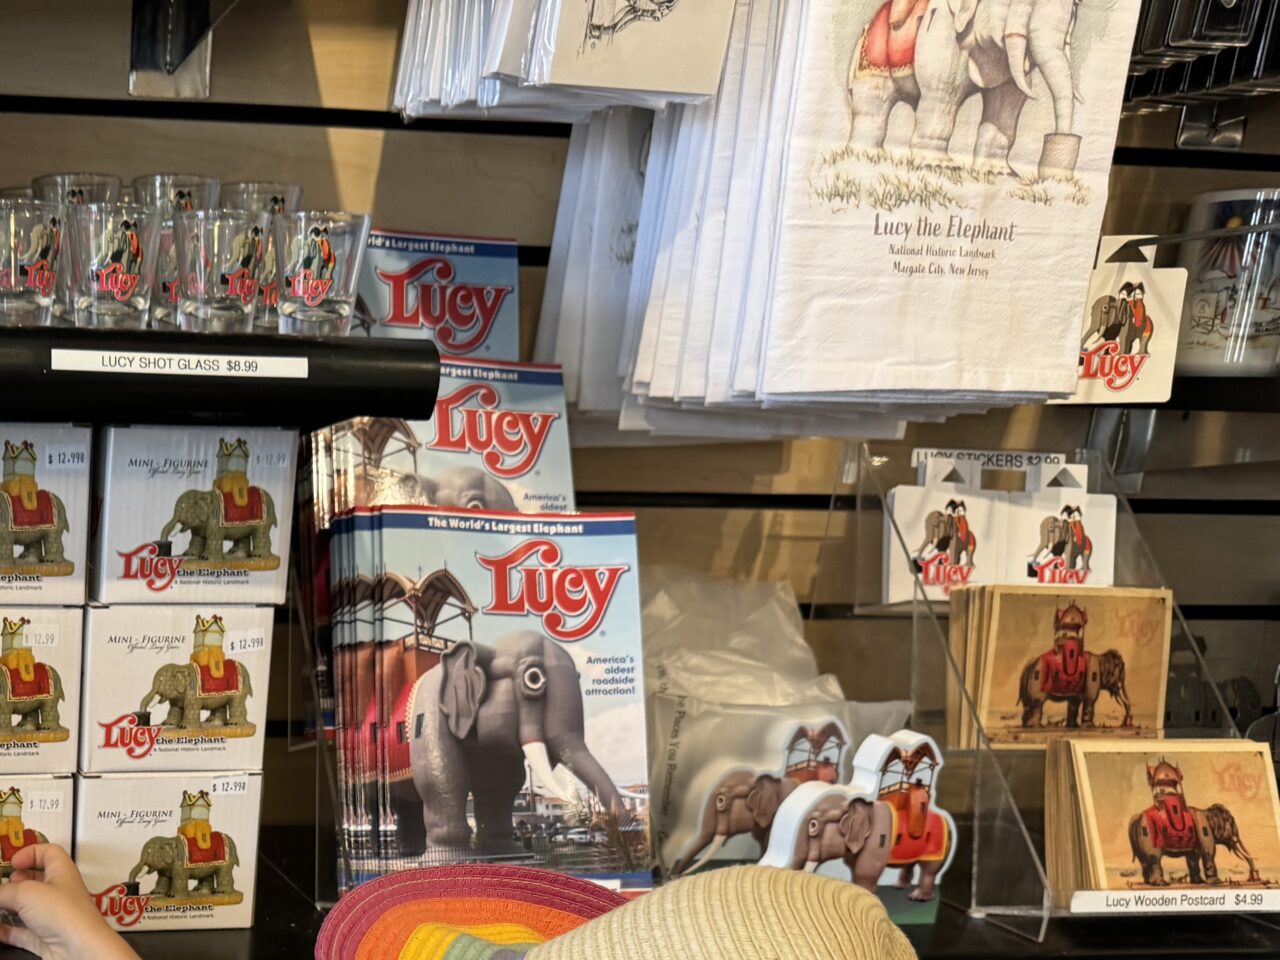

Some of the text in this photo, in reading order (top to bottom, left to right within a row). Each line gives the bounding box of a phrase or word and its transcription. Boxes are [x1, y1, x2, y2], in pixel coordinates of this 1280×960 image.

[874, 212, 1018, 244] Lucy the Elephant
[391, 238, 428, 252] Largest
[429, 241, 475, 255] Elephant
[888, 244, 996, 260] National Historic Landmark
[892, 261, 926, 278] Margate
[948, 263, 965, 275] New
[967, 264, 990, 280] Jersey
[96, 262, 141, 301] Lucy
[289, 270, 333, 307] Lucy
[376, 257, 512, 354] Lucy
[101, 356, 258, 373] LUCY SHOT GLASS $8.99
[1080, 341, 1150, 392] Lucy
[440, 366, 518, 382] argest Elephant
[427, 383, 559, 479] Lucy
[129, 459, 208, 468] MINI FIGURINE
[539, 501, 567, 512] oldest
[428, 517, 584, 535] The World's Largest Elephant
[117, 544, 183, 592] Lucy
[198, 570, 248, 579] Elephant
[475, 538, 629, 642] Lucy
[142, 636, 186, 644] FIGURINE
[586, 655, 635, 665] America's
[604, 665, 635, 675] oldest
[592, 675, 635, 686] roadside
[585, 685, 636, 696] attraction!
[98, 714, 163, 759] Lucy
[130, 810, 174, 818] FIGURINE
[165, 905, 213, 913] Elephant
[1105, 893, 1263, 909] Lucy Wooden Postcard $4.99
